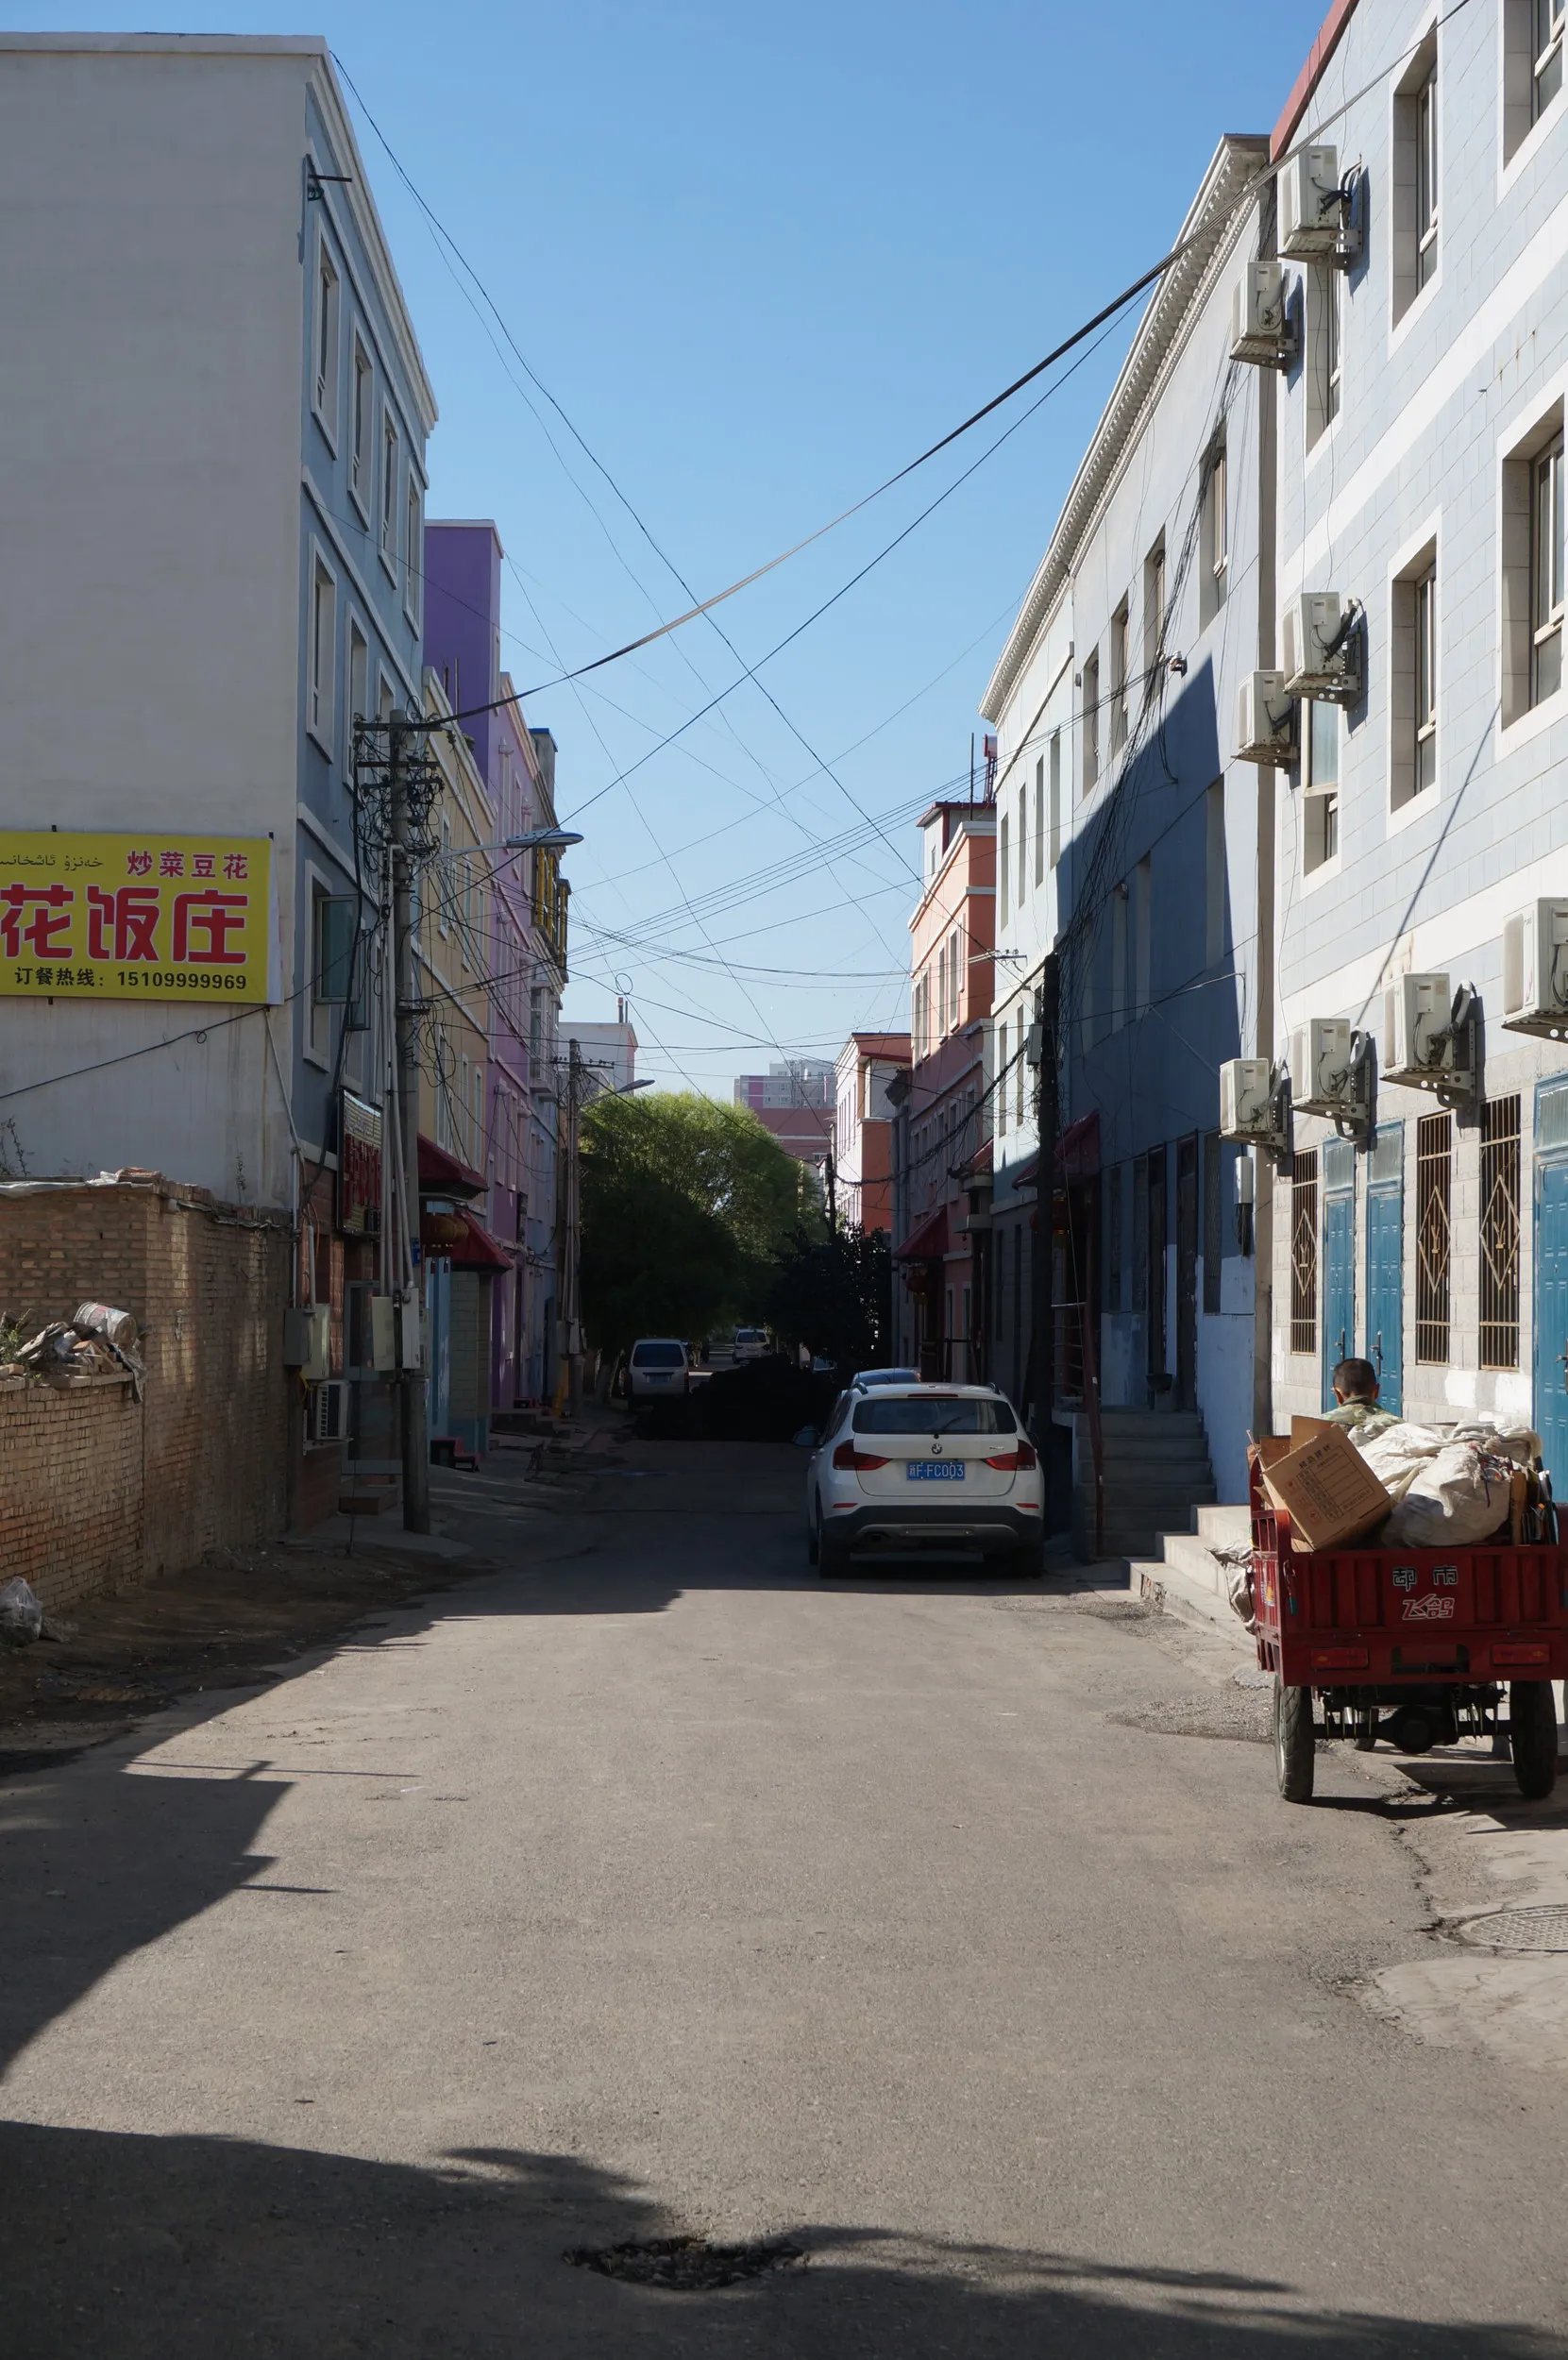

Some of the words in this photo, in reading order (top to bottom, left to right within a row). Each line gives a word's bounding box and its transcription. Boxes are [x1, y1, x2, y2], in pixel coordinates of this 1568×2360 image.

[126, 851, 248, 880] 炒菜豆花
[0, 884, 248, 964] 花饭庄
[117, 971, 247, 990] 15109999969
[1392, 1565, 1458, 1592] 都市
[1402, 1593, 1455, 1620] 飞鸽
